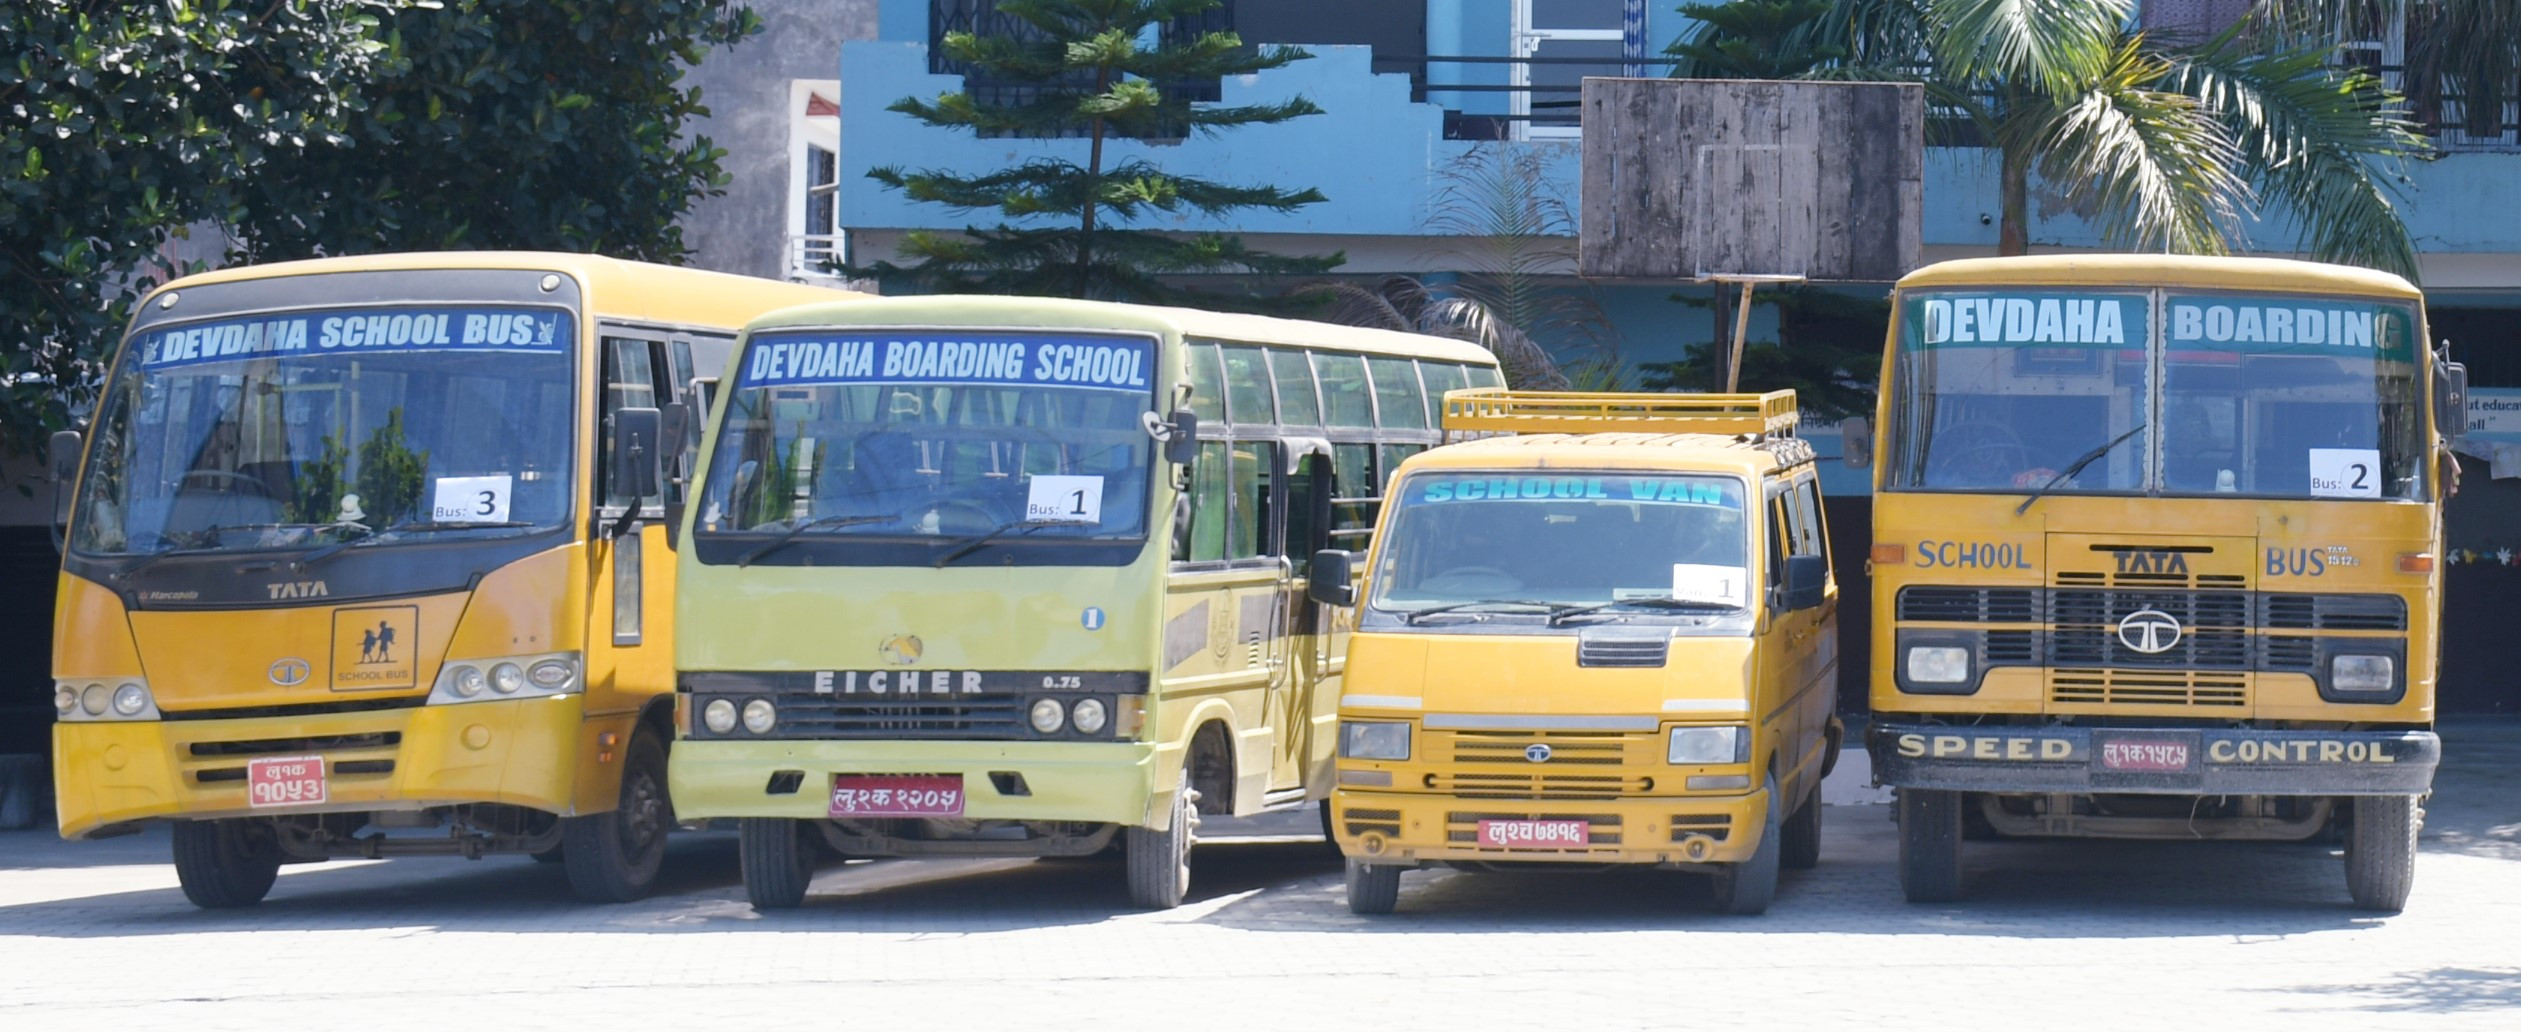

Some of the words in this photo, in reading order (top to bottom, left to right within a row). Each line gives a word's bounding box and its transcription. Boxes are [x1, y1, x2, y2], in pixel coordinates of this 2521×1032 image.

[1924, 297, 2125, 344] DEVDAHA
[2174, 304, 2403, 350] BOARDING
[162, 319, 308, 363] DEVDAHA
[319, 314, 451, 348] SCHOOL
[462, 314, 534, 346] BUS
[750, 341, 874, 381] DEVDAHA
[883, 340, 1026, 379] BOARDING
[1034, 343, 1146, 387] SCHOOL
[2312, 477, 2342, 490] Bus:
[2350, 463, 2369, 490] 2
[1029, 503, 1060, 516] Bus:
[1069, 489, 1088, 516] 1
[1424, 477, 1607, 502] SCHOOL
[1629, 479, 1722, 505] VAN
[435, 506, 467, 518] Bus:
[476, 490, 496, 516] 3
[1914, 540, 2032, 570] SCHOOL
[2266, 546, 2326, 577] BUS
[2327, 546, 2349, 554] TATA
[2112, 551, 2188, 574] TATA
[267, 580, 329, 600] TATA
[1717, 578, 1736, 600] 1
[1085, 608, 1100, 629] 1
[337, 671, 383, 681] SCHOOL
[386, 669, 409, 680] BUS
[814, 671, 983, 694] EICHER
[1042, 676, 1081, 689] 0.75
[1897, 734, 2073, 760] SPEED
[2209, 740, 2395, 763] CONTROL
[255, 778, 320, 802] १०५३
